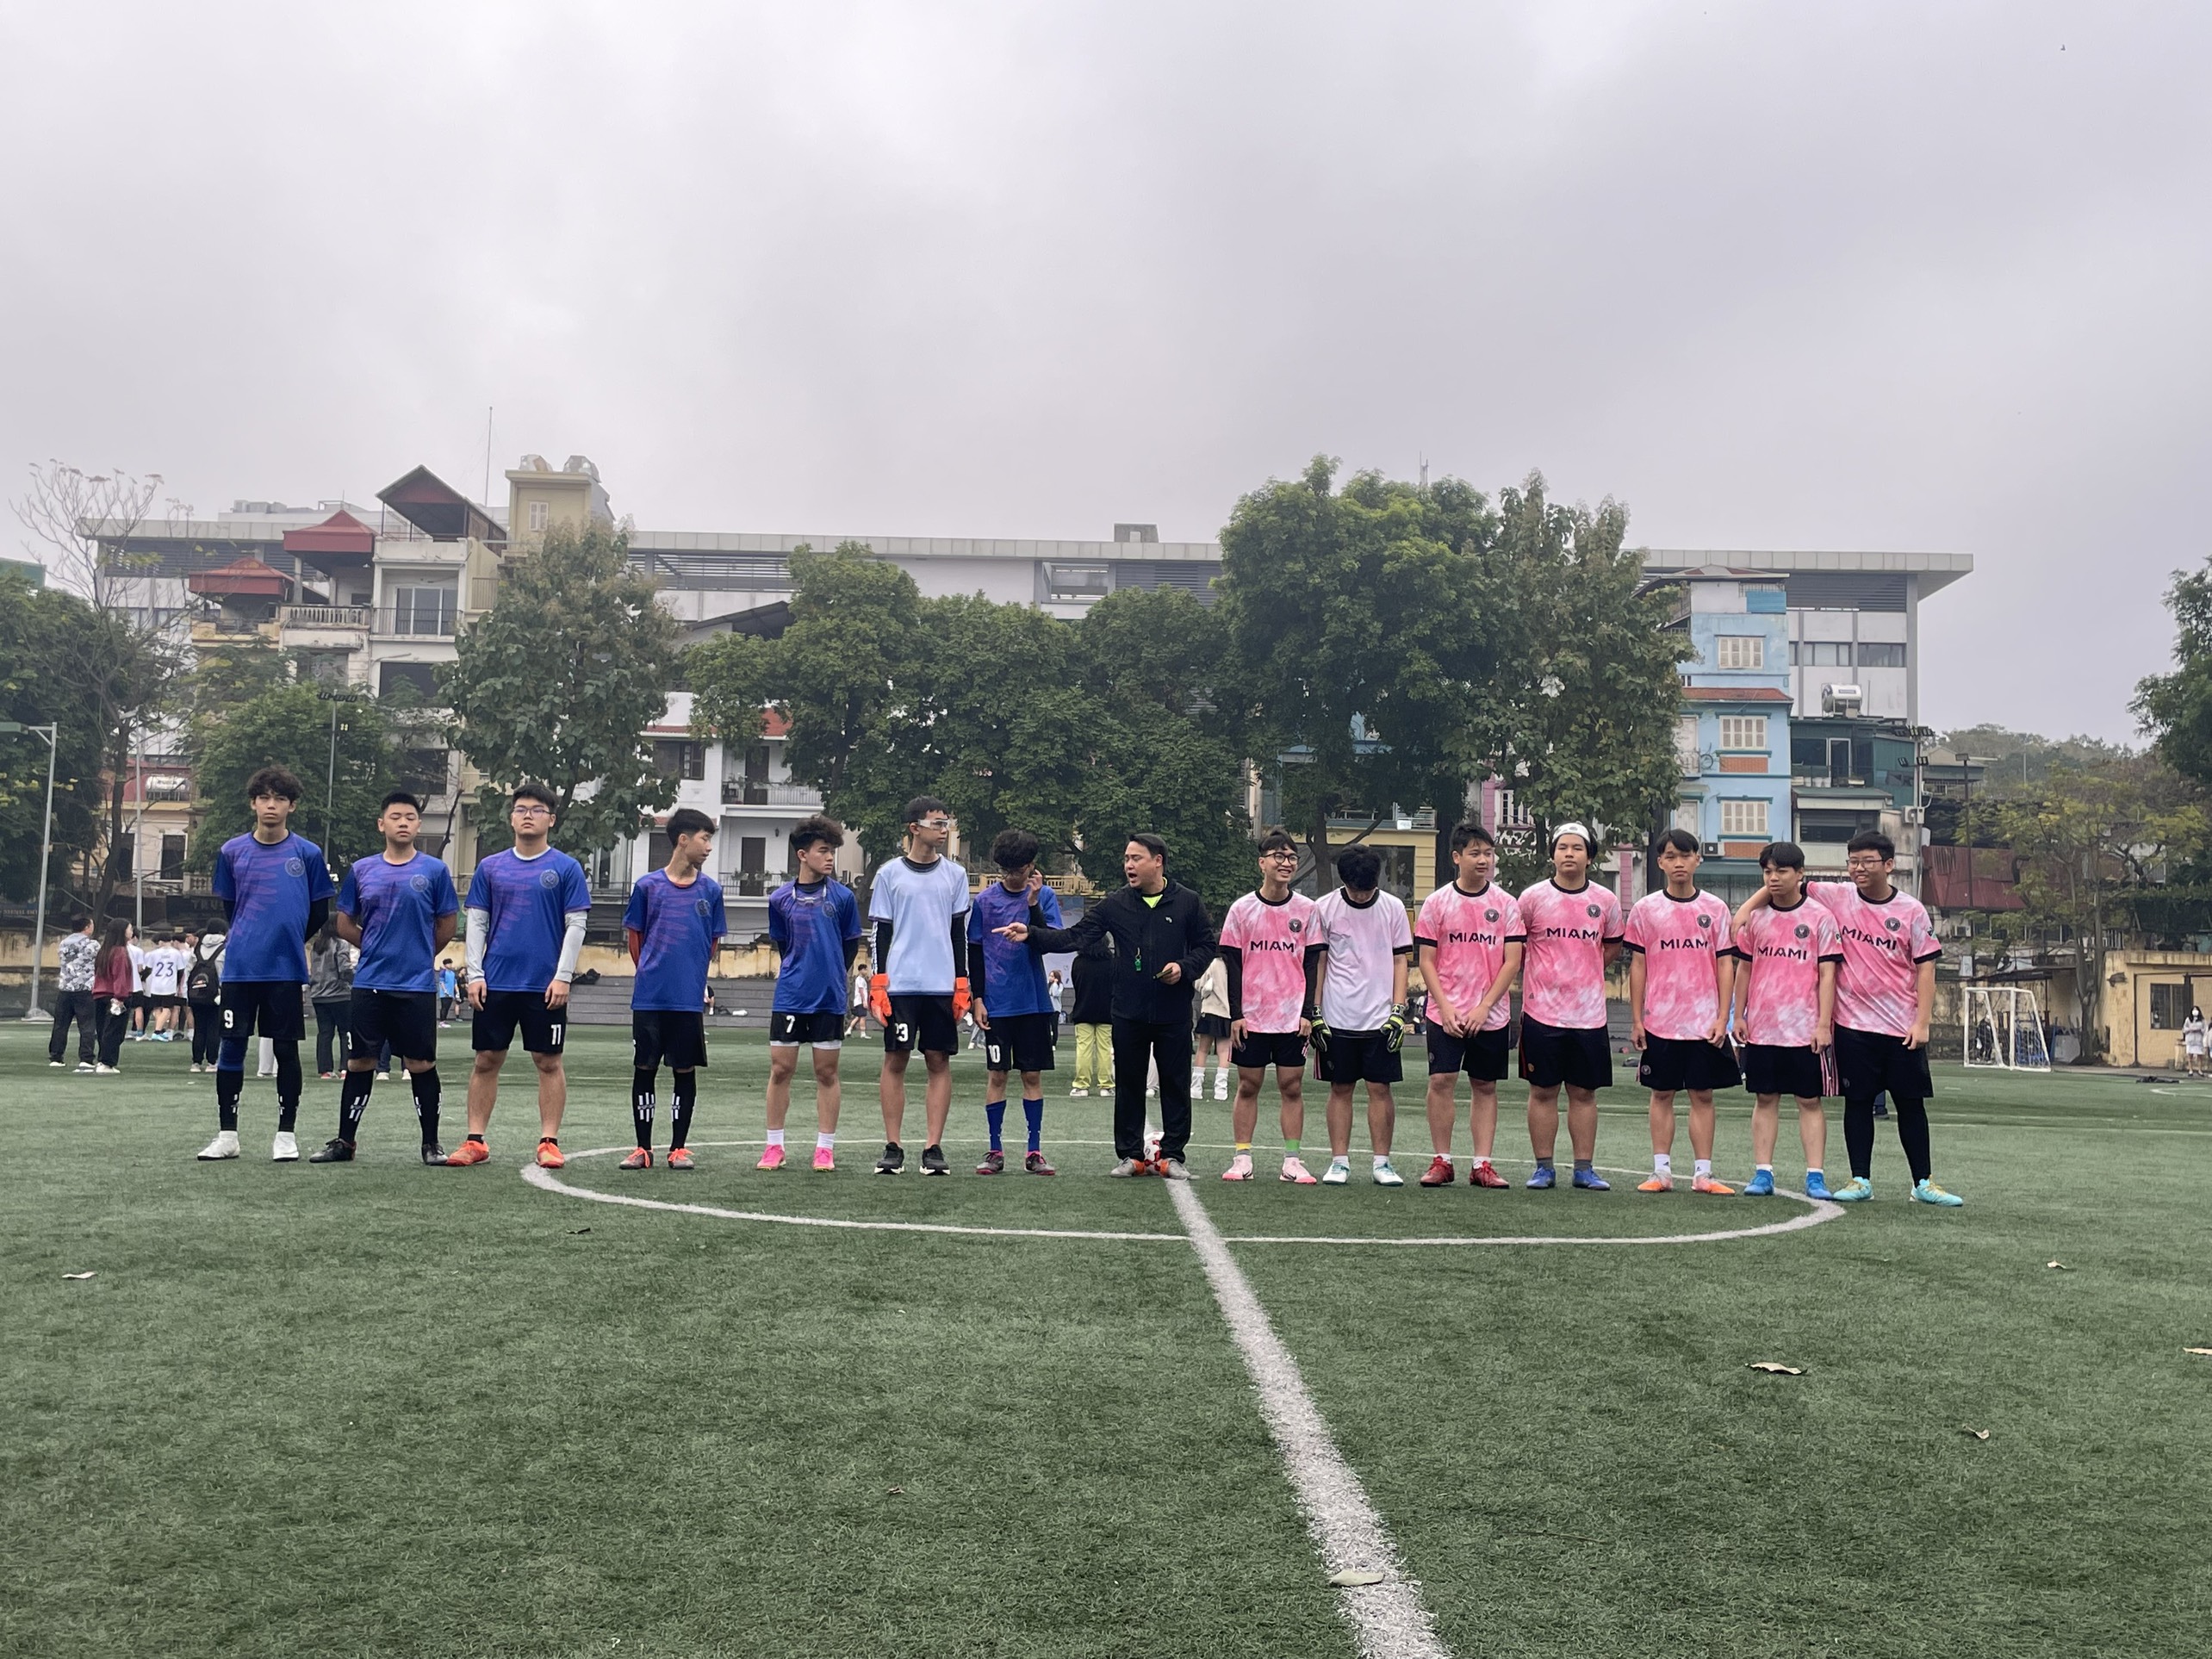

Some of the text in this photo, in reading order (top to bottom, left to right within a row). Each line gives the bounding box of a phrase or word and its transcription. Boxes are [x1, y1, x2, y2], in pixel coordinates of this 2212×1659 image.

[1450, 933, 1496, 945] MIAMI
[1547, 928, 1599, 941] MIAMI
[1842, 925, 1897, 950] MIAMI
[1251, 941, 1296, 953] MIAM
[1758, 947, 1807, 960] MIAMI
[155, 962, 174, 977] 23
[224, 1010, 233, 1028] 9
[786, 1016, 795, 1033] 7
[551, 1024, 562, 1045] 11
